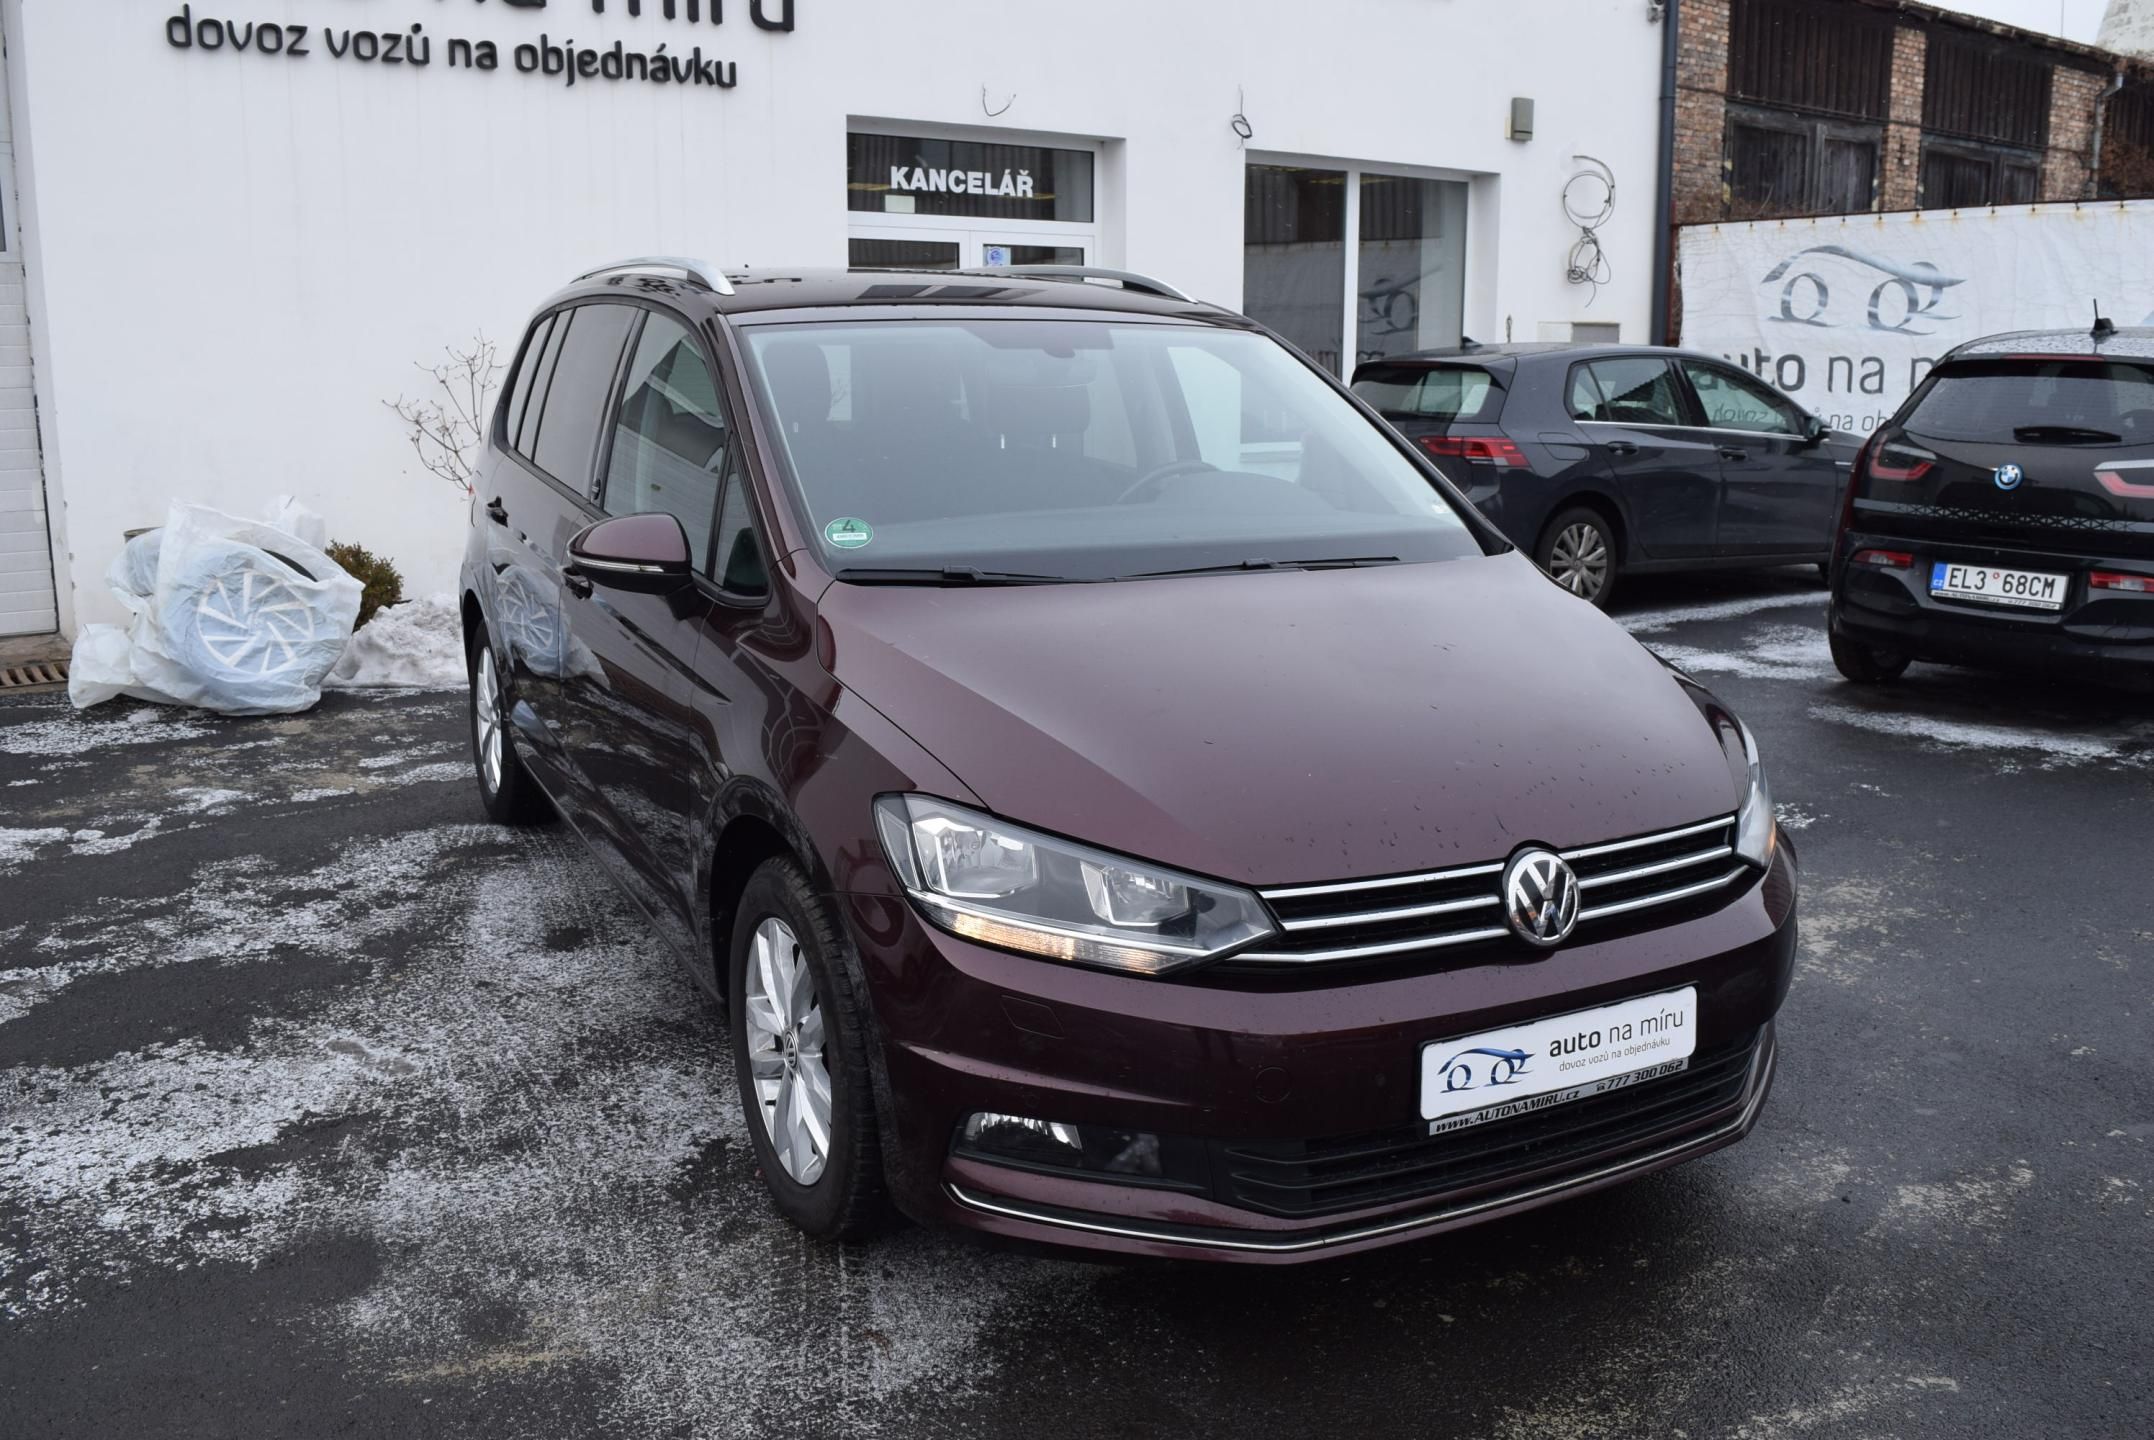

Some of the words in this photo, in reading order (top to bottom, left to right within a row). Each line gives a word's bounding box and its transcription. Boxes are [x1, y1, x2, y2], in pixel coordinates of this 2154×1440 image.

[165, 3, 309, 57] dovoz
[324, 22, 430, 66] vozů
[447, 38, 499, 70] na
[514, 33, 738, 89] objednávku
[889, 165, 1034, 198] KANCELÁŘ
[1827, 355, 1885, 394] na
[842, 519, 856, 533] 4
[1949, 567, 1987, 590] EL3
[2002, 573, 2056, 598] 68CM
[1549, 1030, 1601, 1058] auto
[1609, 1023, 1632, 1044] na
[1640, 1007, 1684, 1036] míru
[1559, 1058, 1586, 1072] dovoz
[1588, 1050, 1609, 1065] vozů
[1611, 1049, 1622, 1060] na
[1624, 1037, 1671, 1057] objednávku
[1607, 1074, 1631, 1090] 777
[1632, 1067, 1658, 1083] 300
[1659, 1060, 1684, 1075] 062
